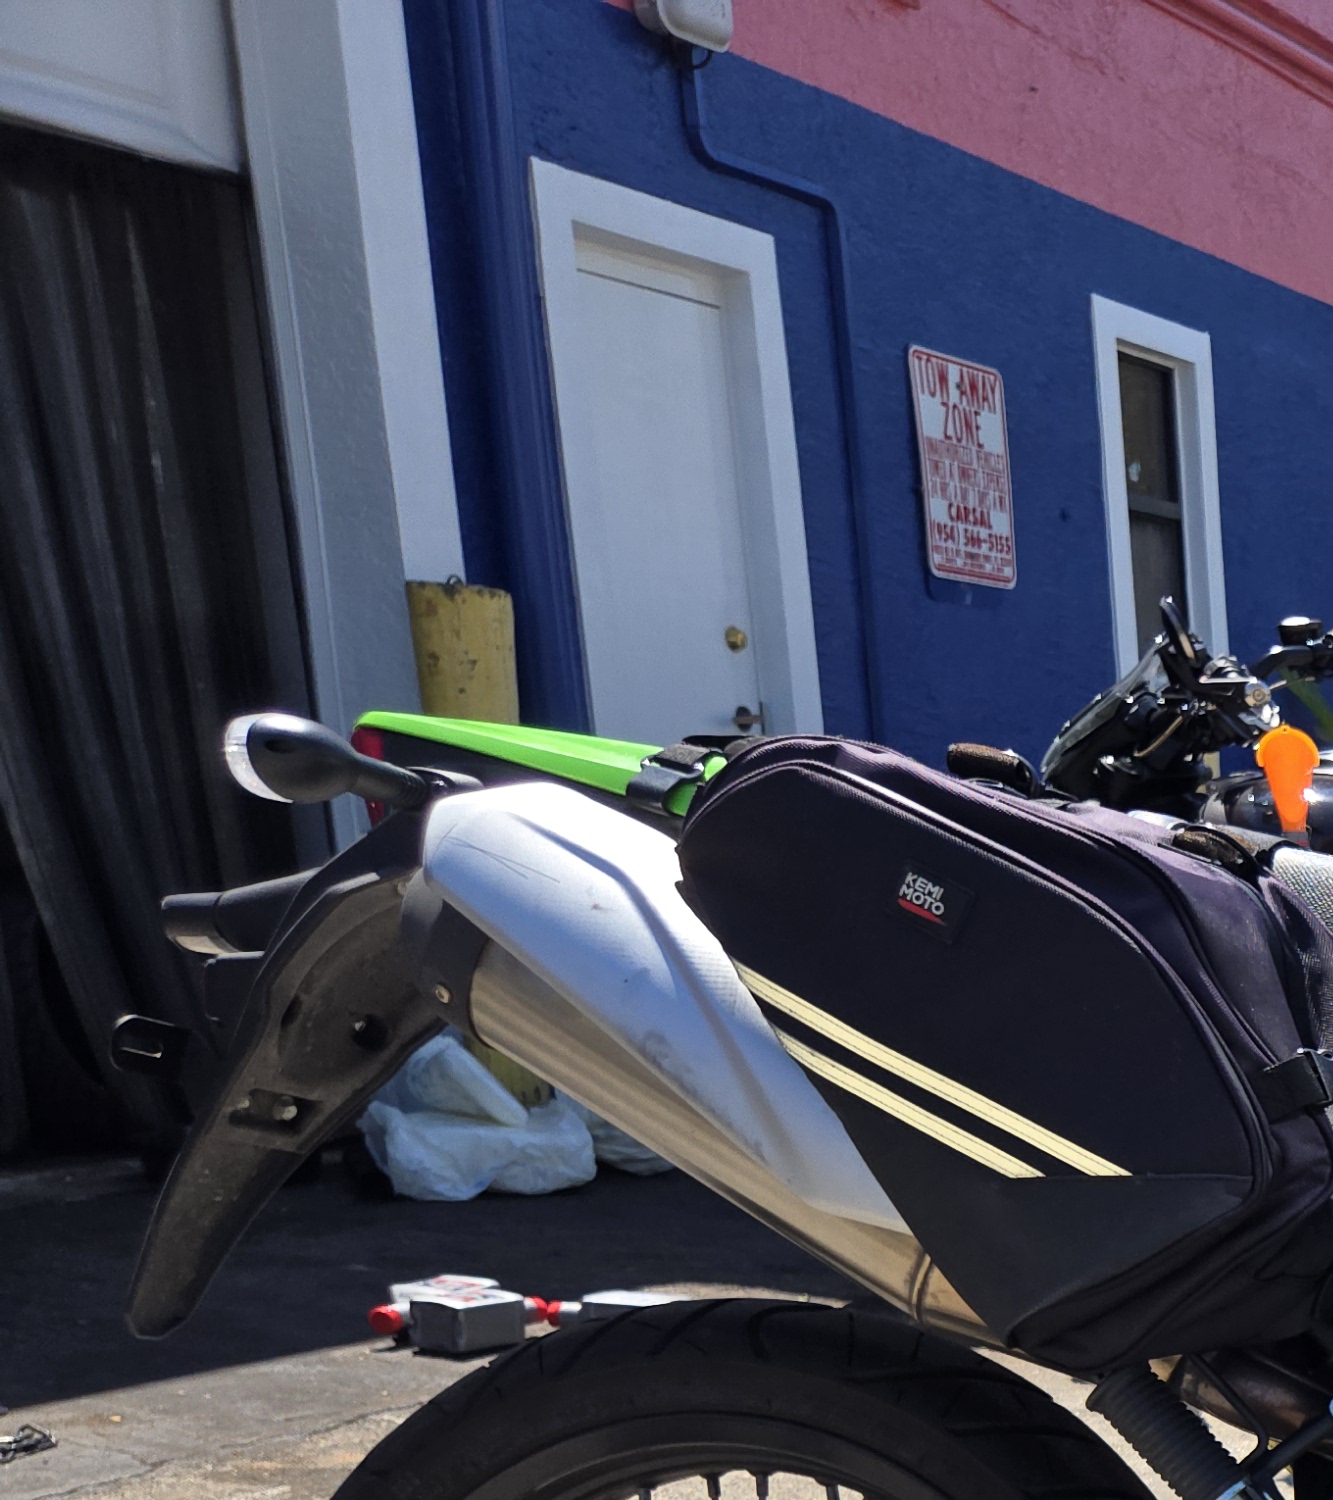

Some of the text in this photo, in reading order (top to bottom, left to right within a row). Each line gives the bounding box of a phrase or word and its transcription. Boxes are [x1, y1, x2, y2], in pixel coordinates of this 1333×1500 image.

[916, 355, 998, 415] TOW AWAY
[941, 400, 985, 449] ZONE
[899, 883, 945, 916] MOTO
[905, 872, 944, 900] KEMI
